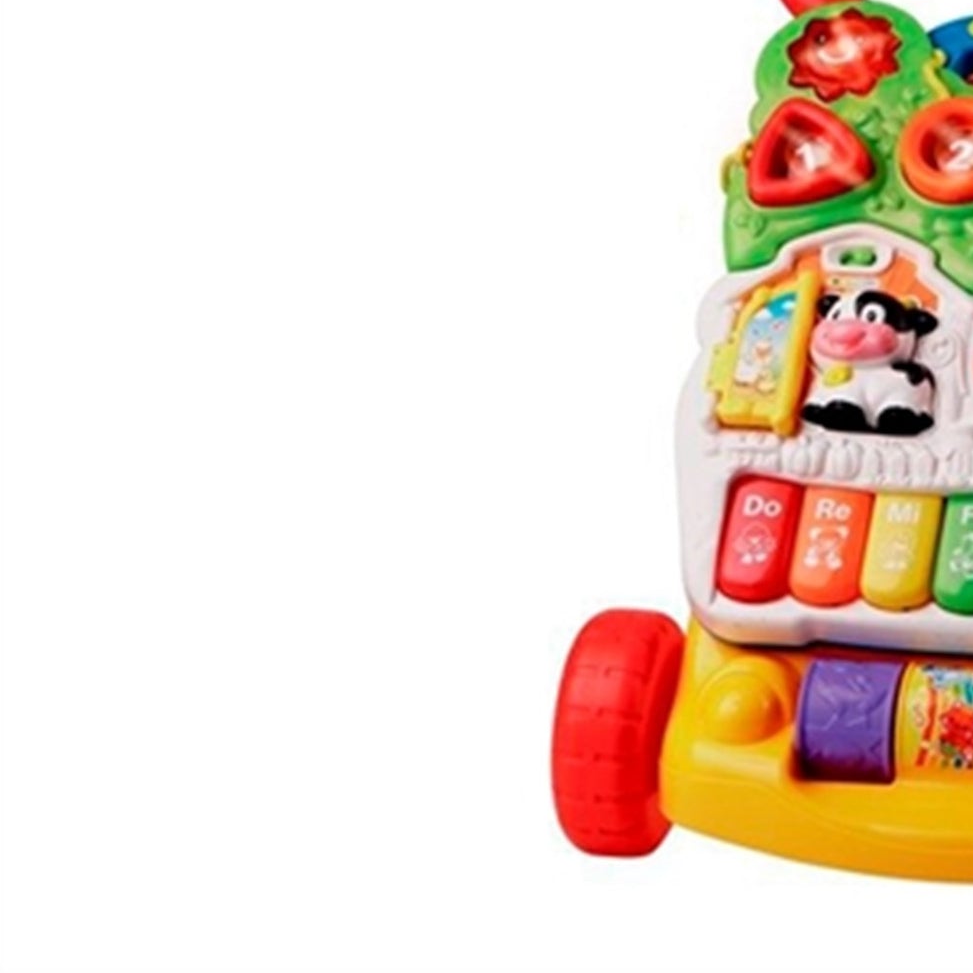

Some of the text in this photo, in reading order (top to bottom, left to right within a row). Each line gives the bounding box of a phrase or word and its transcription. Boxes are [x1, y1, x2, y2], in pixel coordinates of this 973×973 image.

[795, 142, 817, 172] 1
[743, 494, 782, 517] Do
[815, 498, 852, 521] Re
[886, 501, 921, 523] Mi
